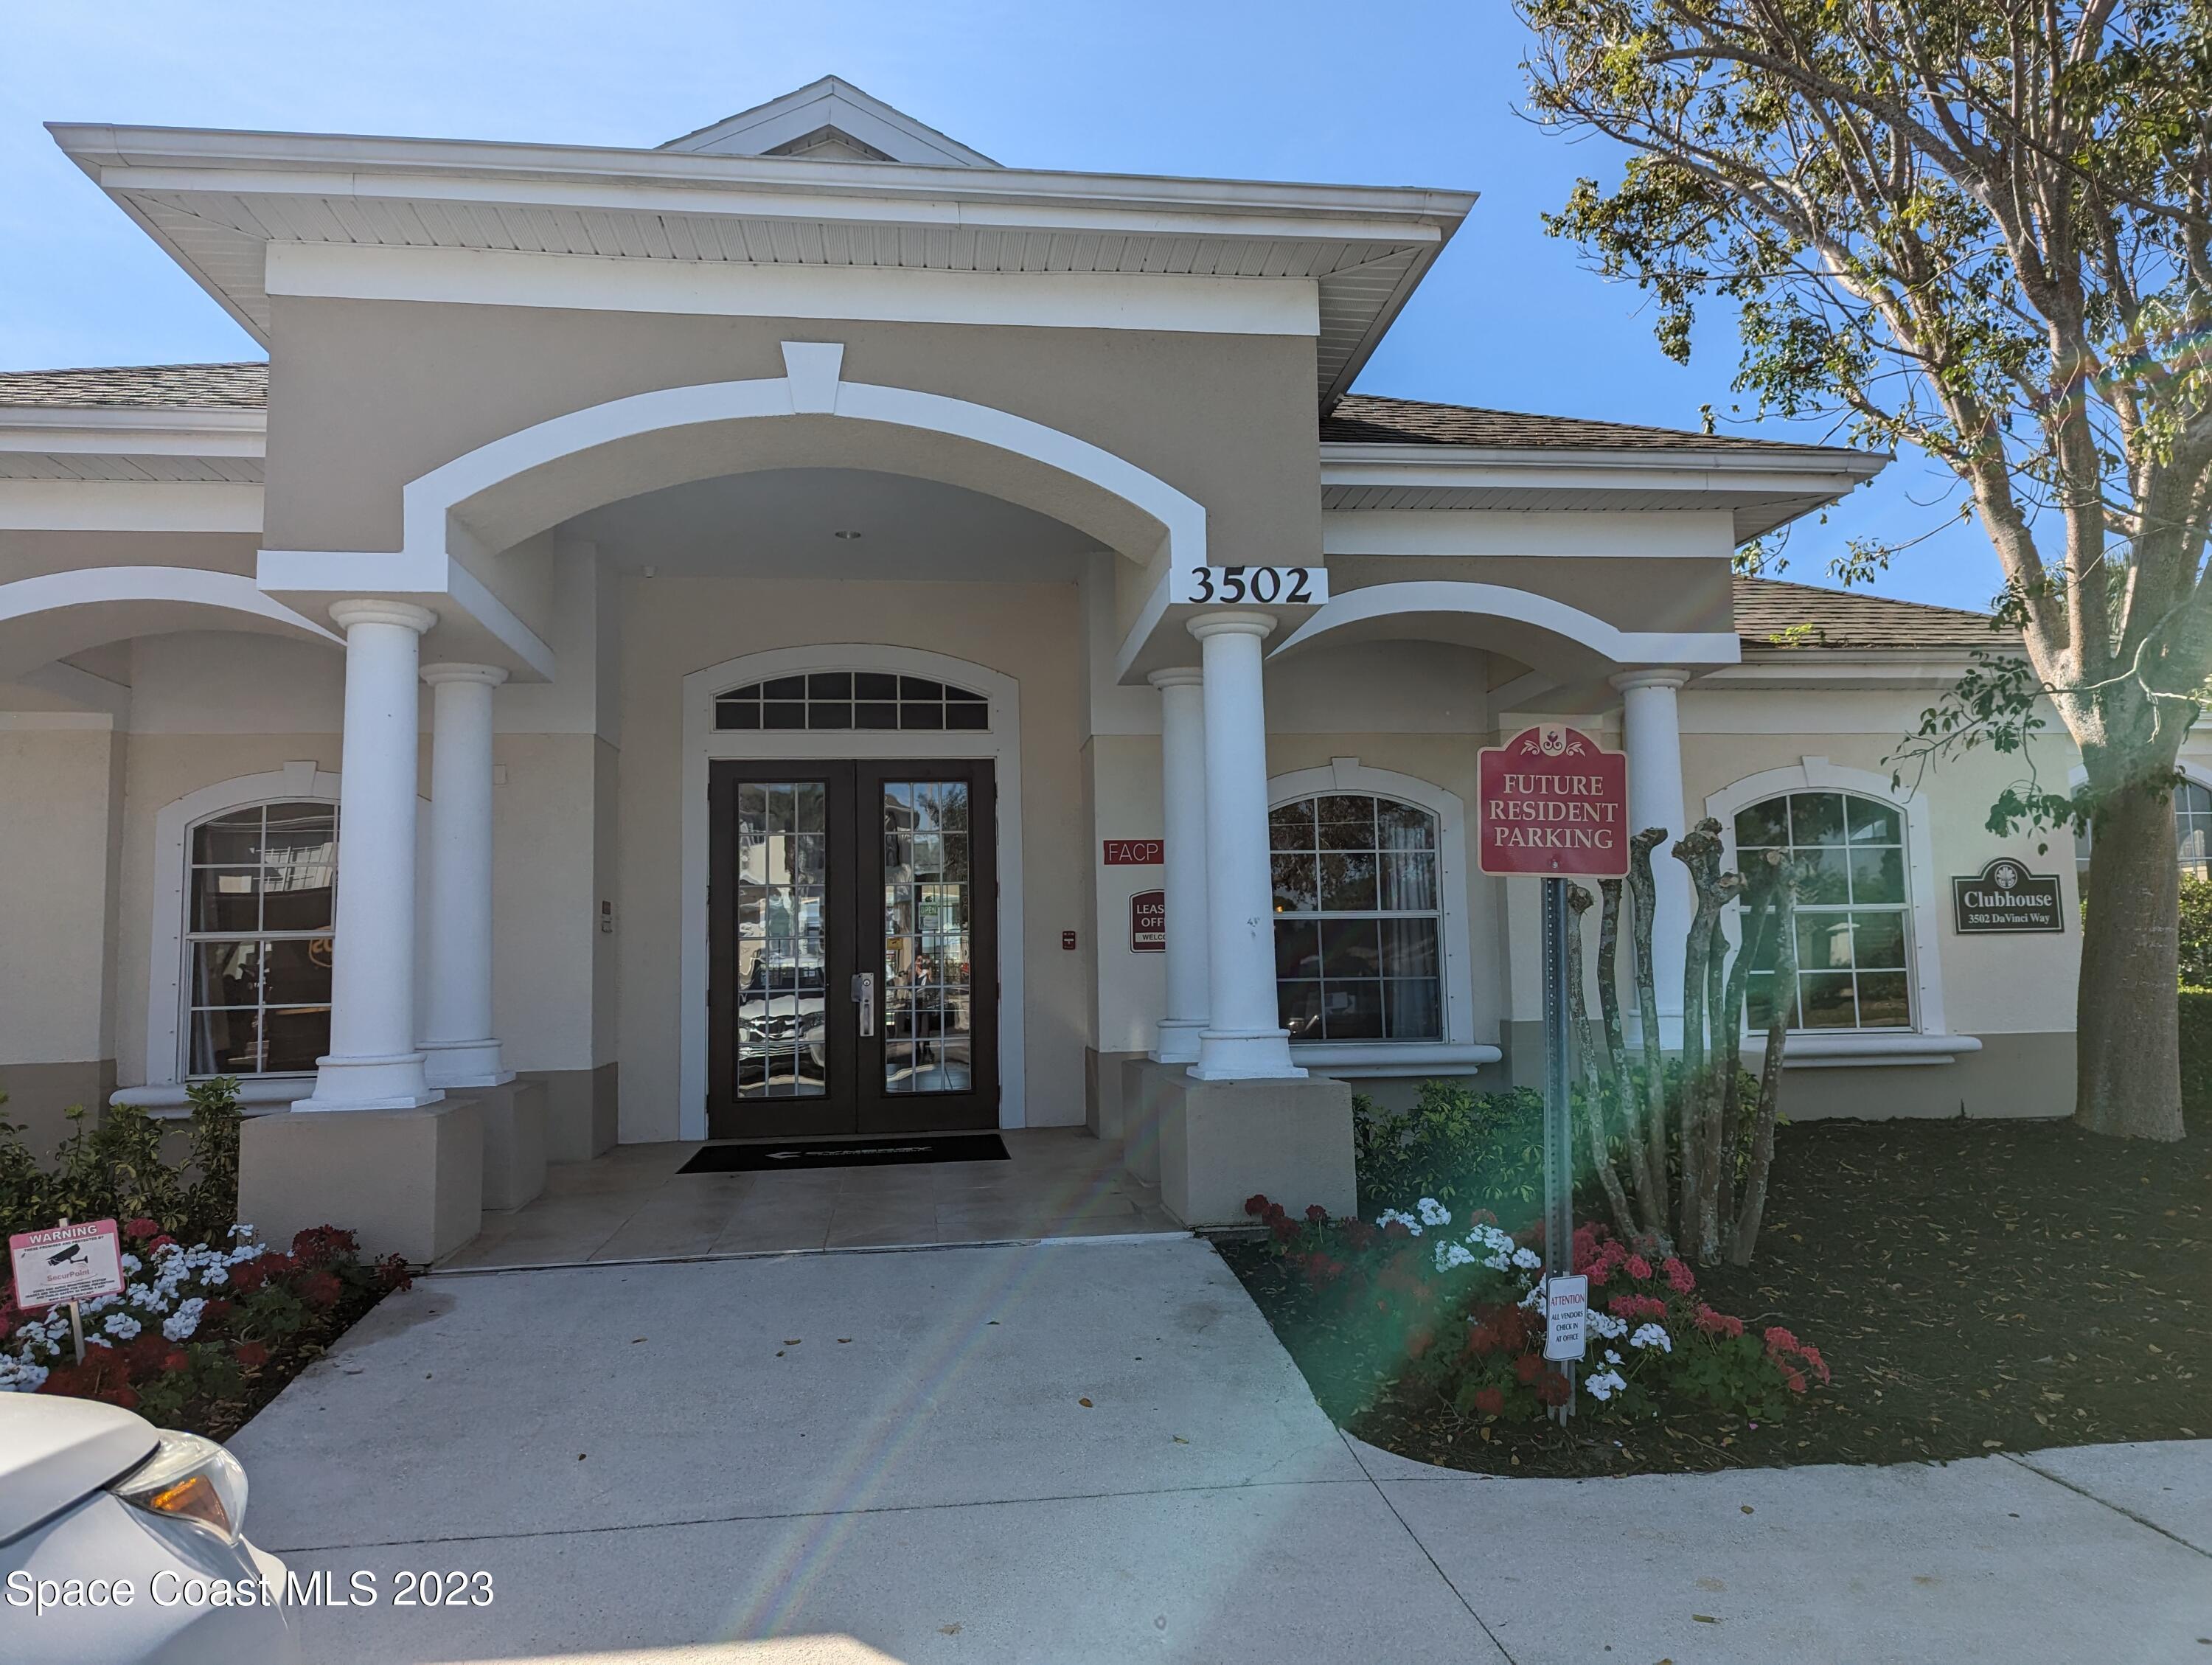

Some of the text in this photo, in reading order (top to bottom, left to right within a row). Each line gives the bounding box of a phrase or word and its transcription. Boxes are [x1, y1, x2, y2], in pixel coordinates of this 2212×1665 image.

[1188, 566, 1312, 603] 3502
[1503, 774, 1604, 796] FUTURE
[1489, 800, 1618, 822] RESIDENT
[1494, 827, 1613, 849] PARKING
[1109, 844, 1158, 861] FACP
[1964, 891, 2053, 908] Clubhouse
[1141, 917, 1165, 927] OFF
[1968, 913, 2051, 925] 3502 DaVinci Way
[29, 1225, 97, 1244] WARNING
[47, 1269, 90, 1282] SecurPoint
[1551, 1294, 1585, 1306] ATTENTION
[1561, 1310, 1583, 1319] VENDORS
[1556, 1324, 1572, 1332] CHECK
[1563, 1333, 1579, 1341] OFFICE
